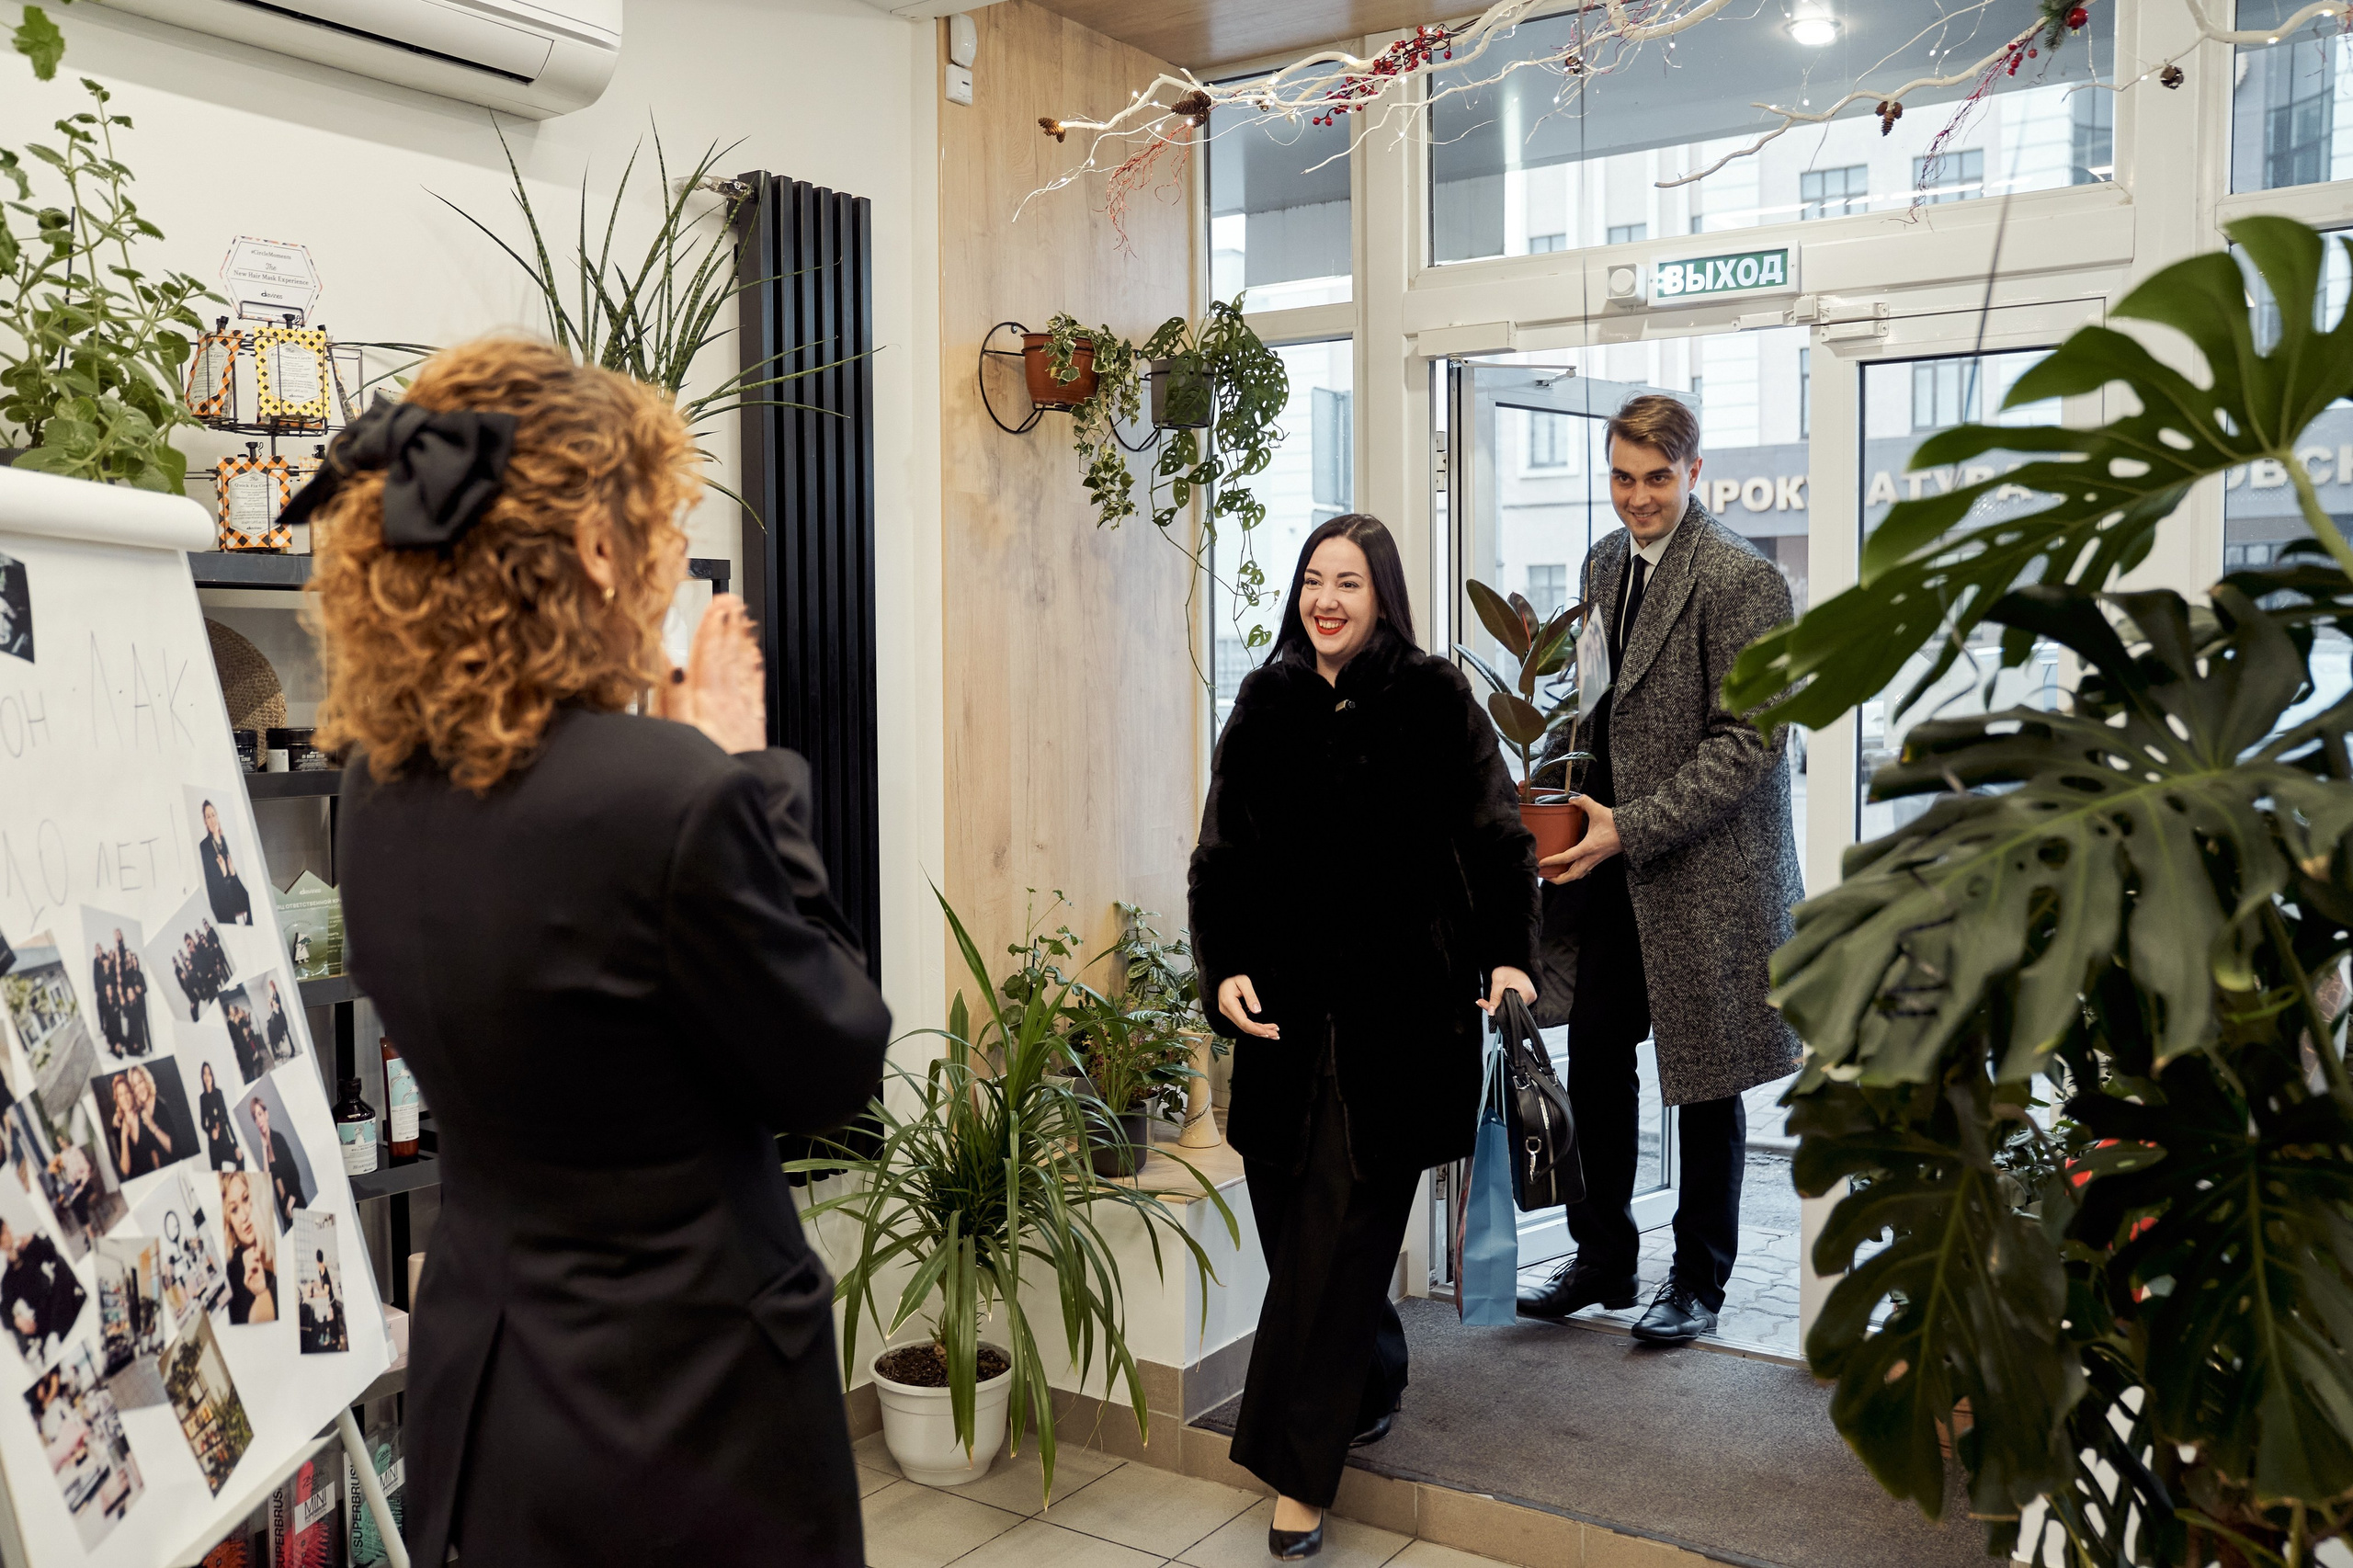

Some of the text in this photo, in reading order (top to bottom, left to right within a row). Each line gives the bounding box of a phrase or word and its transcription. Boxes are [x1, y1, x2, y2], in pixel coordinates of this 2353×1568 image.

[251, 249, 291, 260] #CircleMoments
[265, 262, 277, 271] The
[1663, 254, 1784, 295] ВЫХОД
[233, 269, 309, 286] New Hair Mask Experience
[285, 898, 332, 909] ОТВЕТСТВЕННОЙ
[380, 1463, 397, 1488] MINI
[304, 1488, 326, 1517] MINI
[272, 1488, 286, 1568] SUPERBRUS
